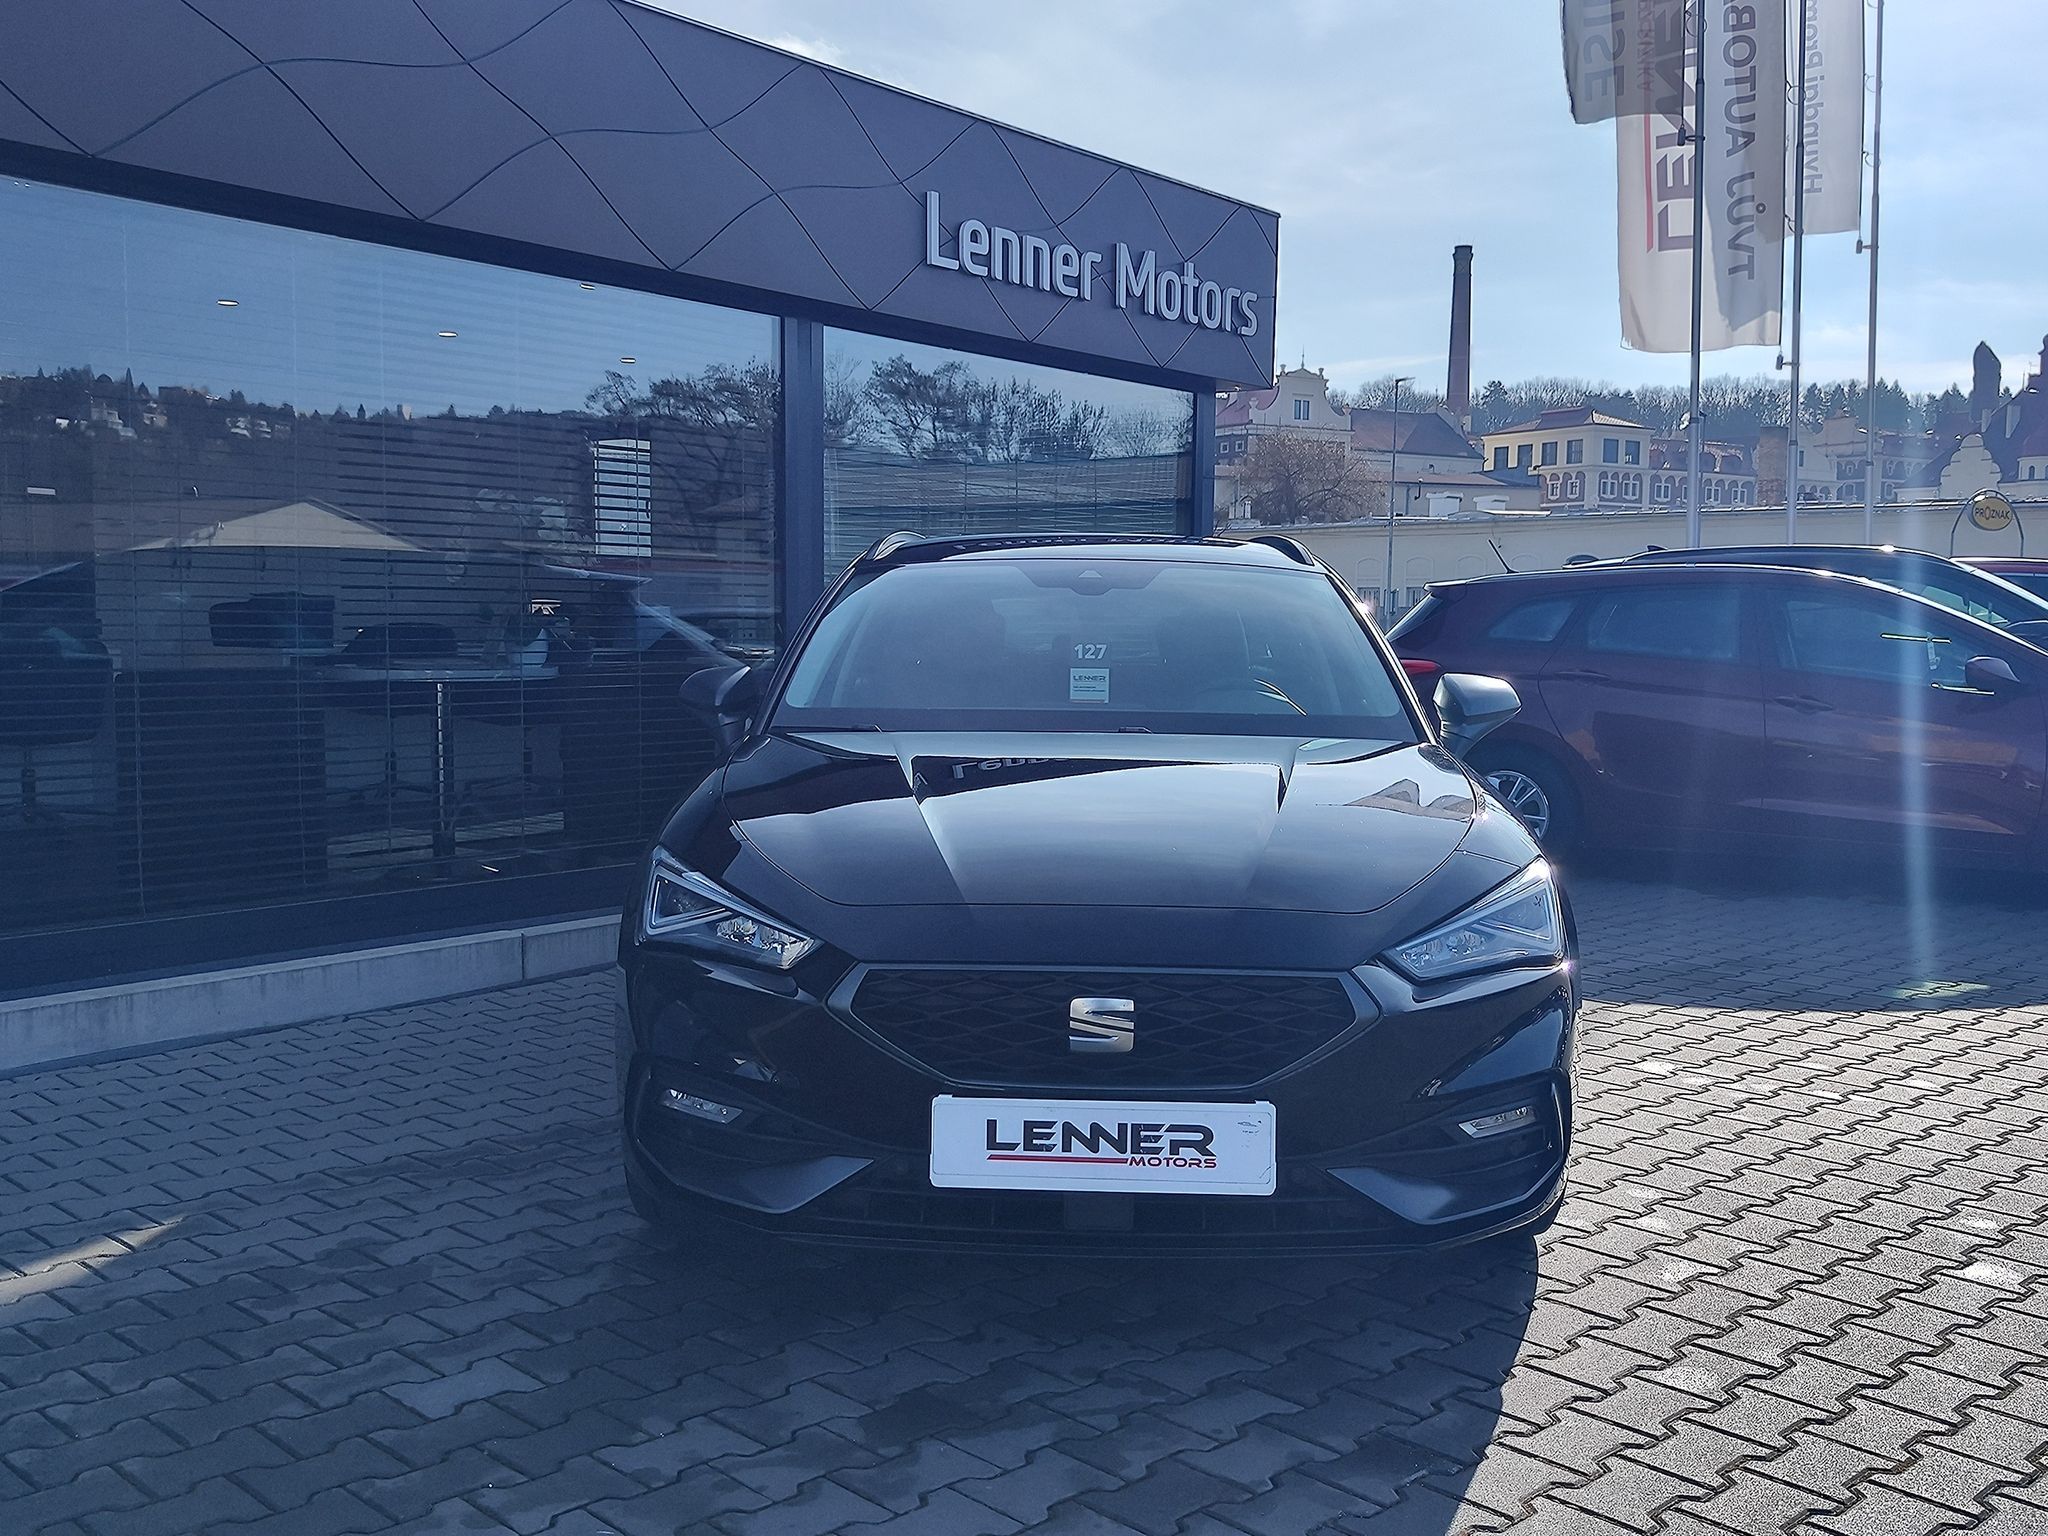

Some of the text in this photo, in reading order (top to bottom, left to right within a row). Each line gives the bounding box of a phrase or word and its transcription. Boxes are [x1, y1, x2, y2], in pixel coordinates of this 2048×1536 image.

[926, 190, 1258, 336] Lenner Motors
[1074, 644, 1107, 659] 127
[986, 1118, 1216, 1157] LENNER
[1128, 1155, 1217, 1169] MOTORS
